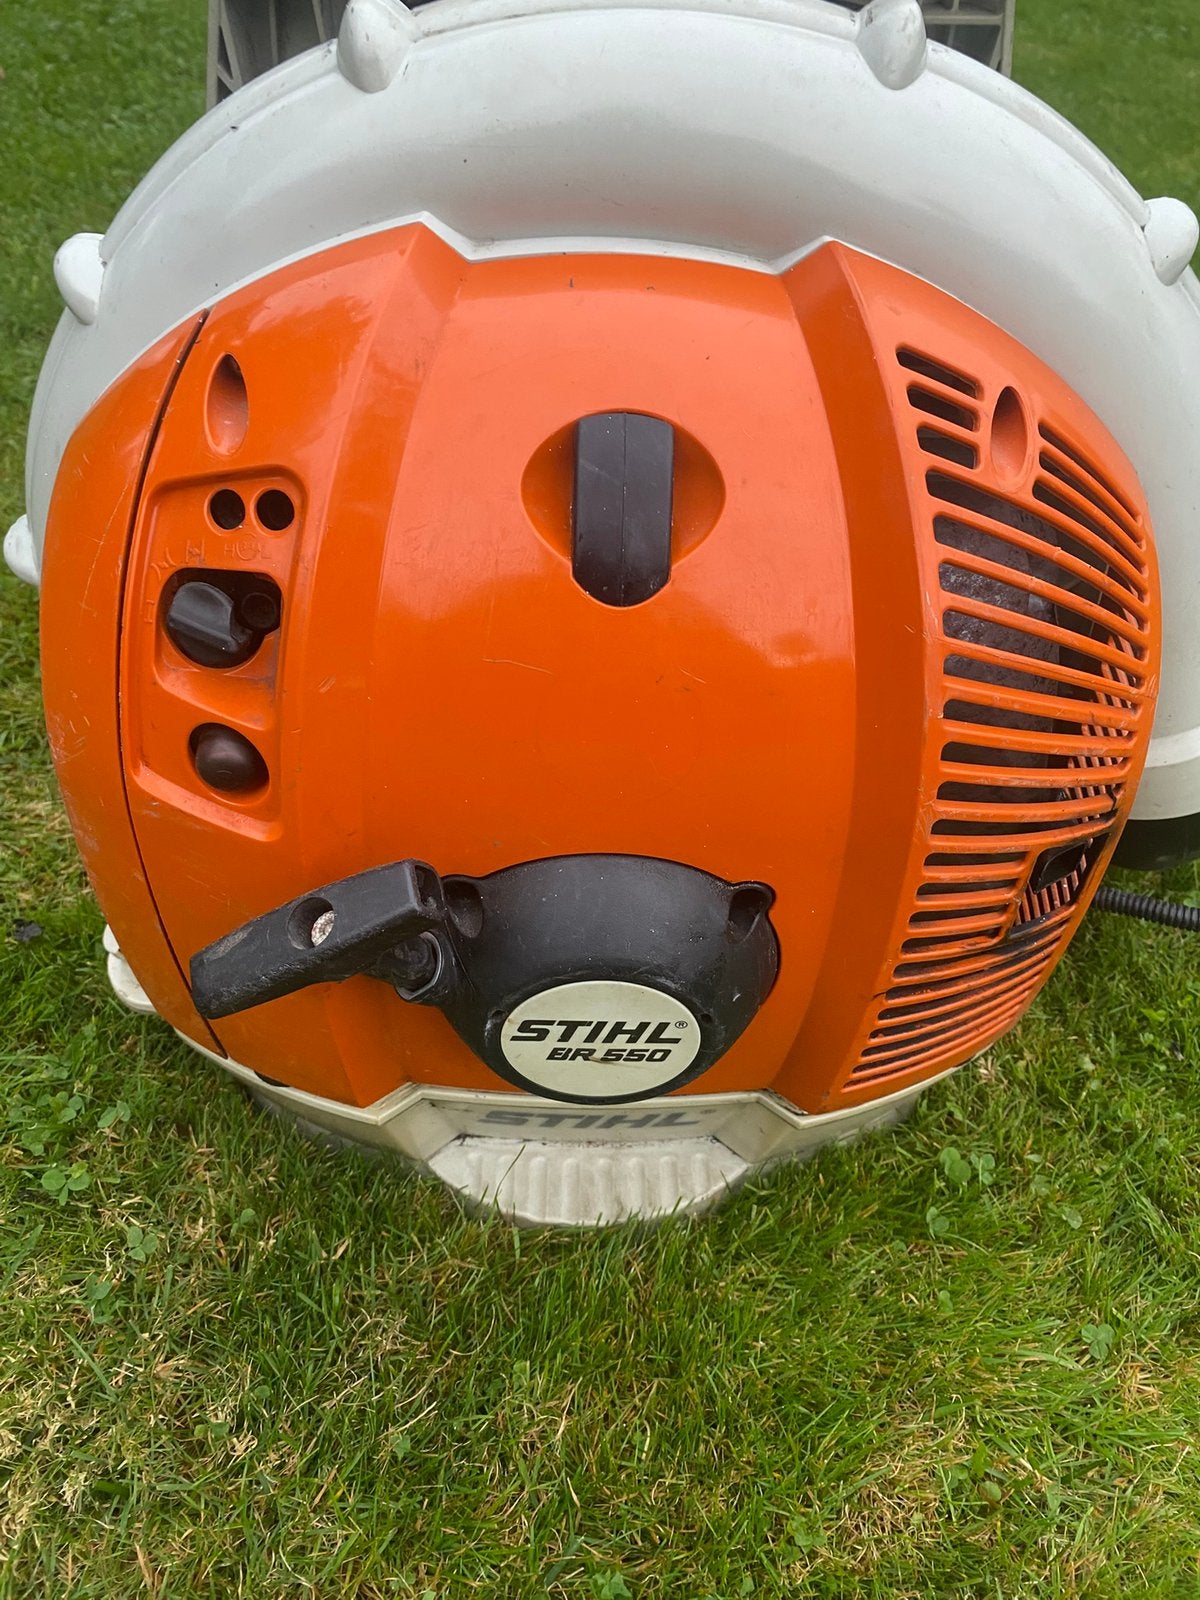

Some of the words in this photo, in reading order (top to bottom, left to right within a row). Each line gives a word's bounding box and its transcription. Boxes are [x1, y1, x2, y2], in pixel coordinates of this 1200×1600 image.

[546, 1047, 595, 1061] BR
[600, 1048, 672, 1062] 550
[477, 1110, 702, 1129] STIHL
